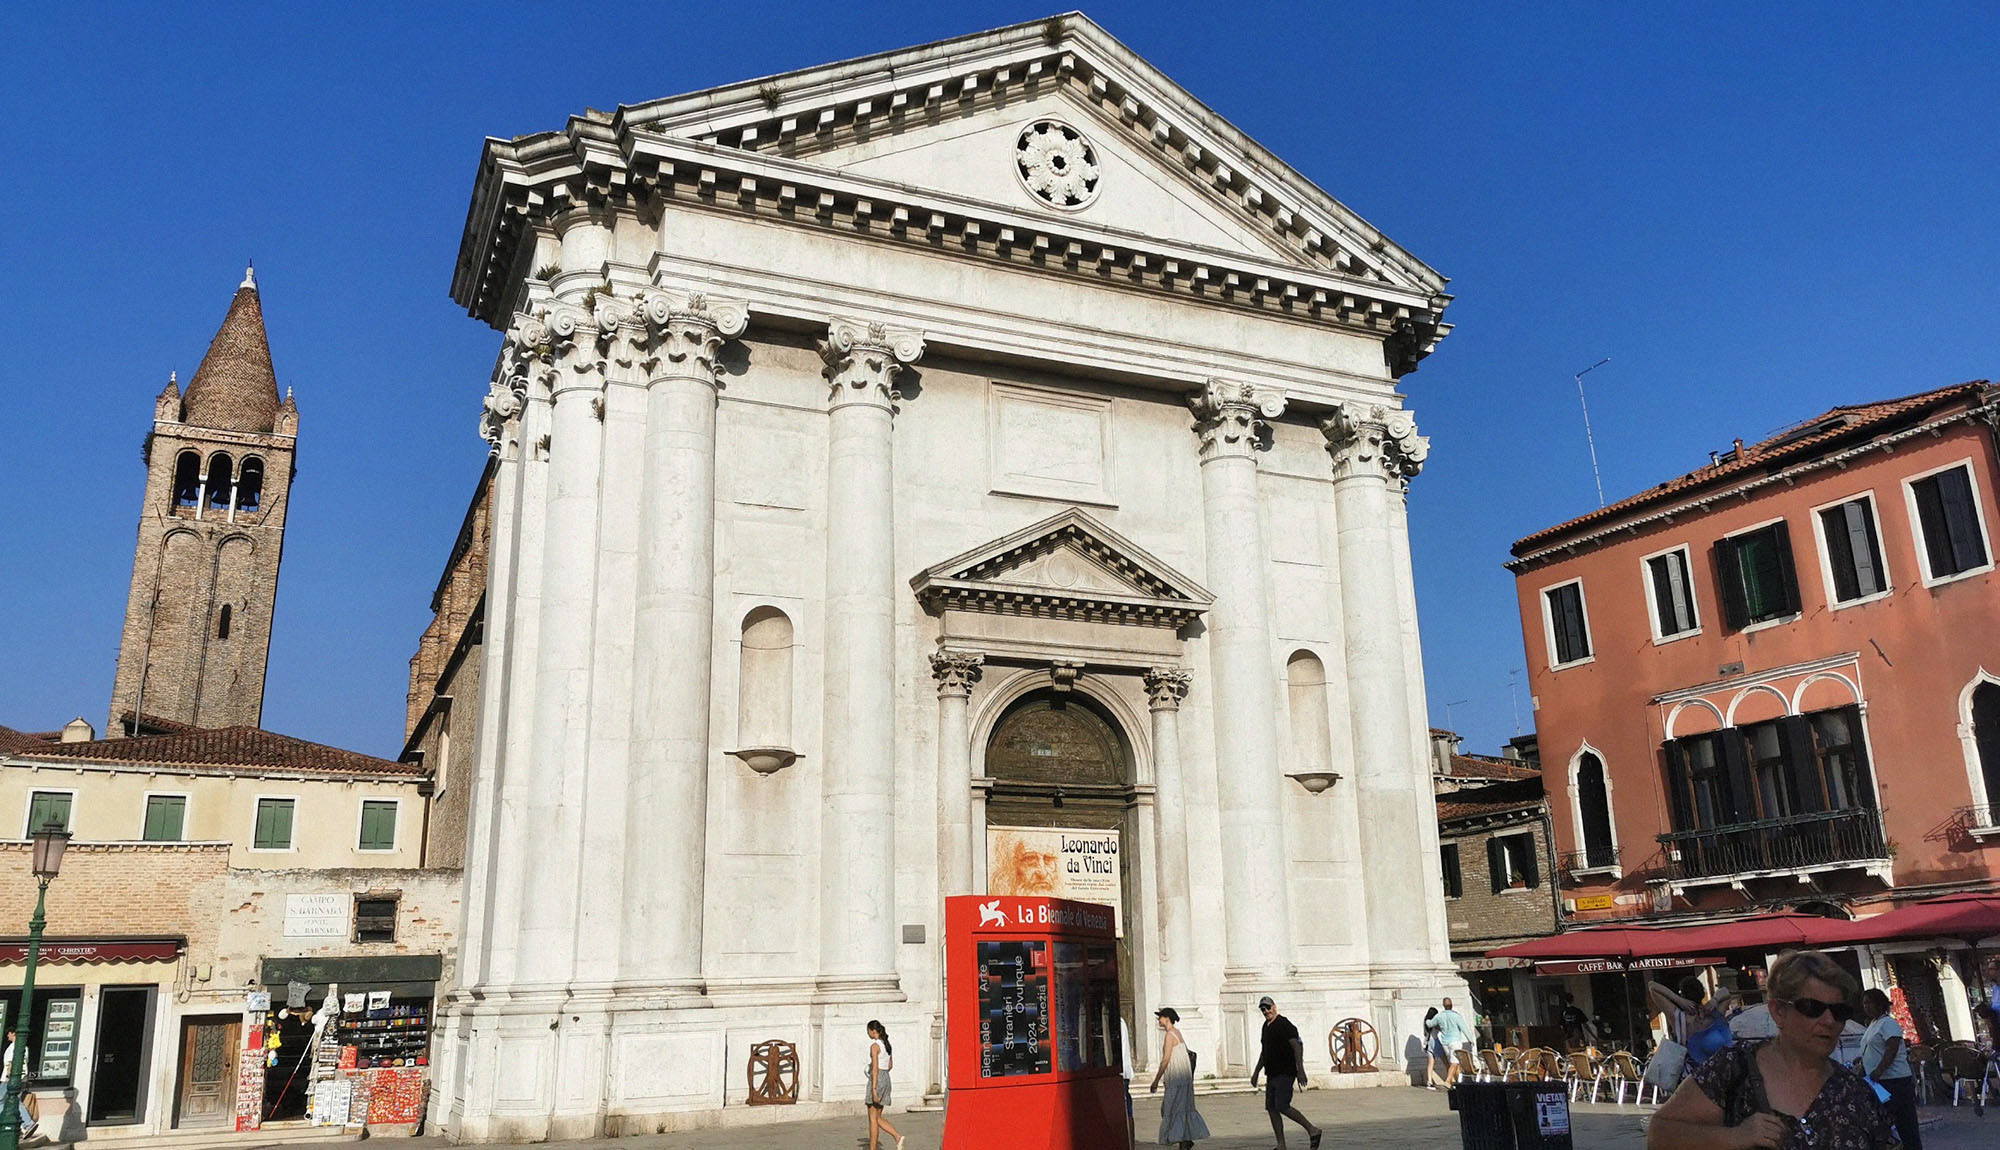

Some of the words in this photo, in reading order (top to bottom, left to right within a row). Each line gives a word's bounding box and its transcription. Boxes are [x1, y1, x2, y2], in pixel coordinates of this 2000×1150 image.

[1061, 835, 1117, 854] Leonardo
[1067, 858, 1080, 873] da
[1083, 855, 1113, 873] Vinci
[301, 896, 334, 904] CAMPO
[1018, 905, 1034, 923] La
[1038, 903, 1074, 926] Biennale
[1075, 907, 1082, 926] di
[1083, 909, 1107, 930] Venezia
[979, 964, 988, 992] Arte
[1003, 996, 1014, 1050] Stranieri
[1015, 955, 1024, 1014] Ovunque
[1028, 1021, 1037, 1054] 2024
[1037, 984, 1048, 1033] Venezia
[982, 1022, 991, 1078] Biennale
